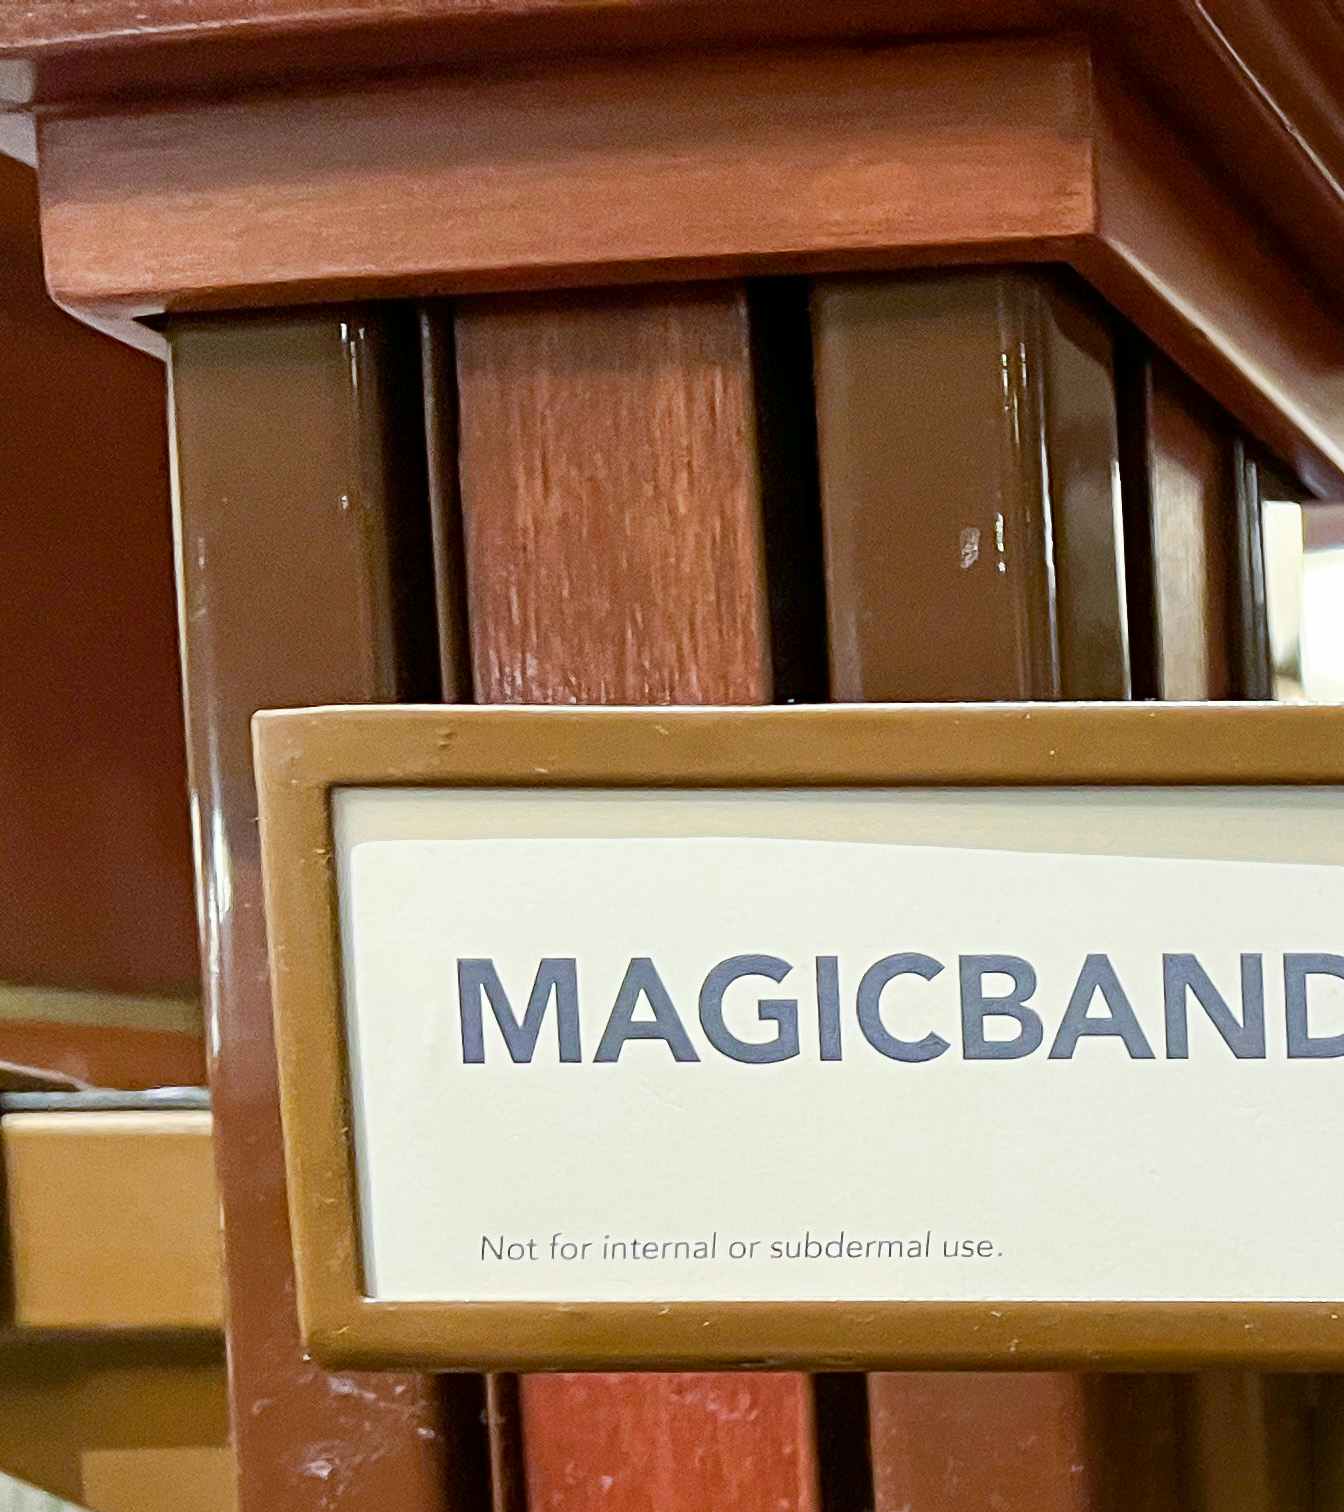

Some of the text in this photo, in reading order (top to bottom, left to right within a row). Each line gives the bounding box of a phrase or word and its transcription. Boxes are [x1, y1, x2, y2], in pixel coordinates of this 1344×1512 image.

[481, 1230, 1003, 1261] Not for internal or subdermal use.
